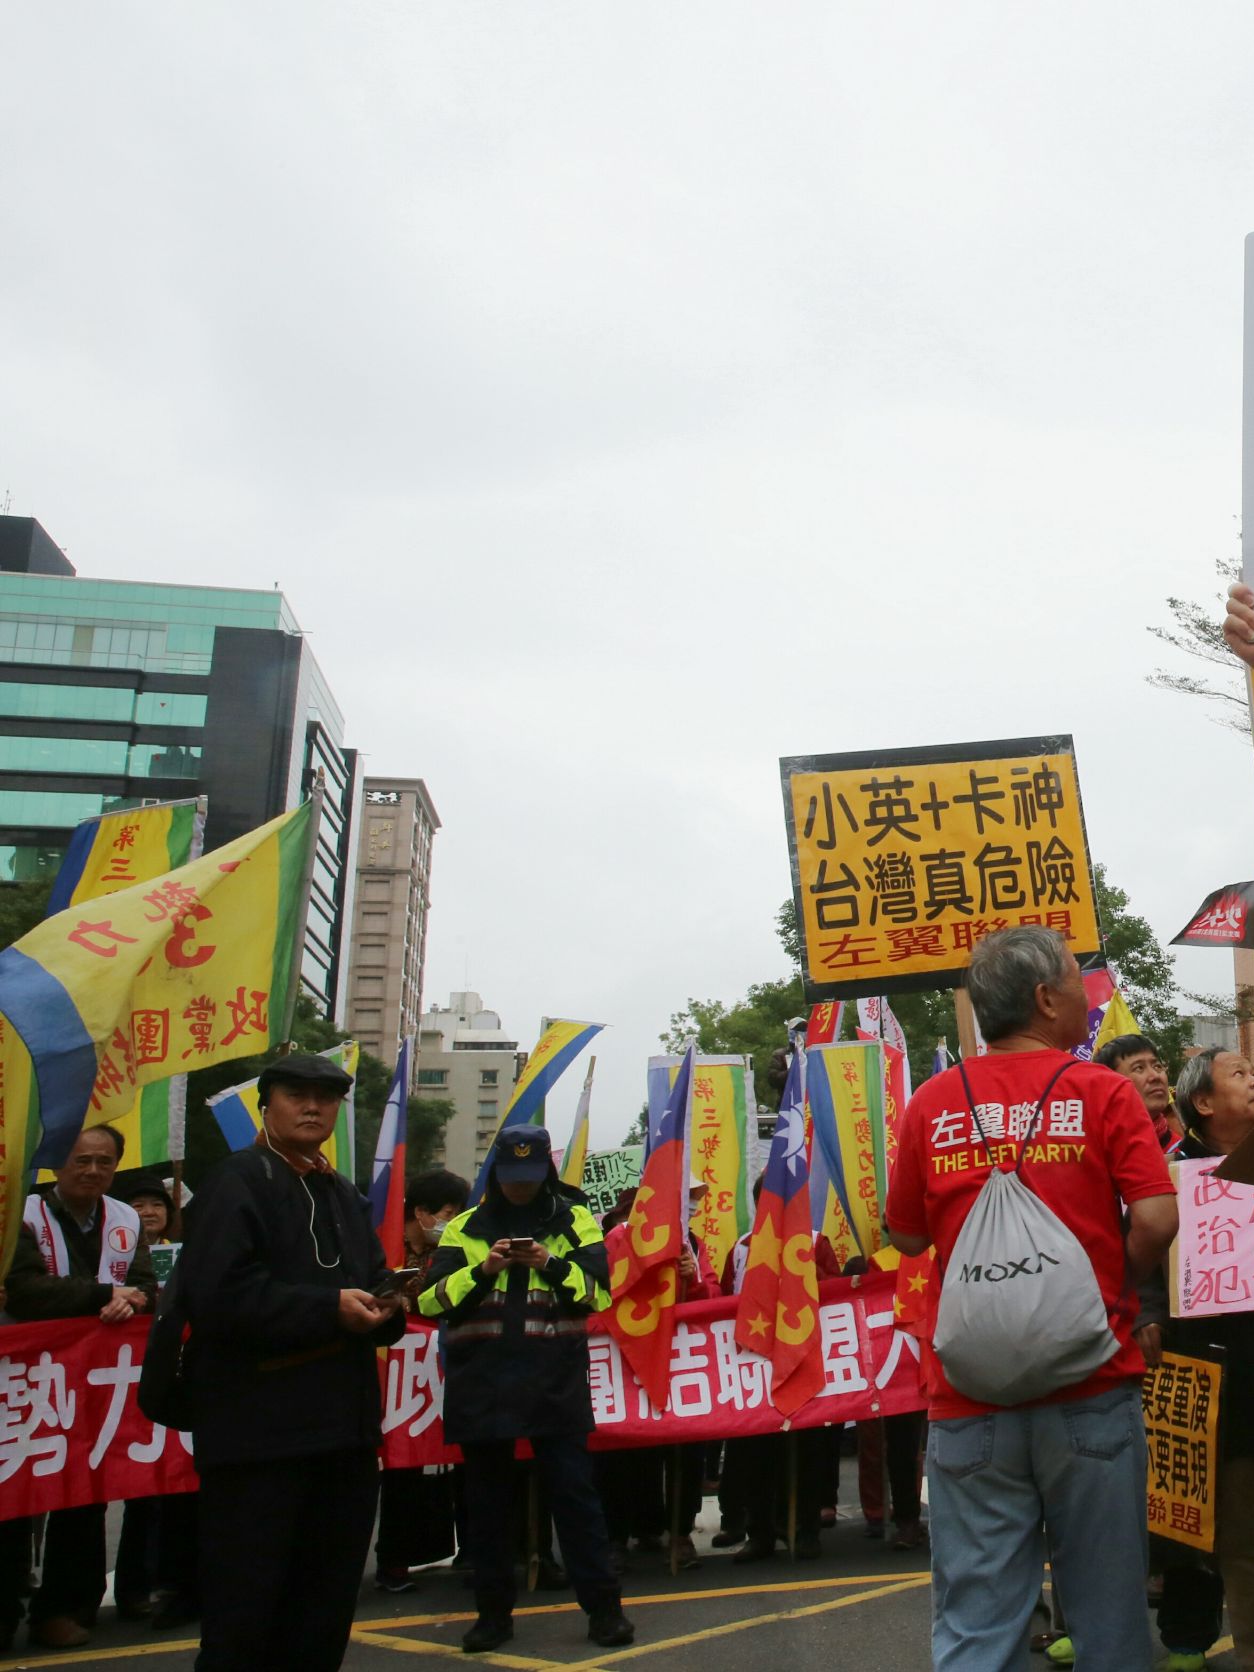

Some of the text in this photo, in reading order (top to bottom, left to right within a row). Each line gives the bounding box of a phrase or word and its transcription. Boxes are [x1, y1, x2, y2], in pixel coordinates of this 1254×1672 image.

[810, 836, 1081, 930] 台灣真危險
[931, 1099, 1086, 1149] 左翼聯盟
[932, 1143, 1086, 1174] THE LEFT PARTY
[115, 1229, 129, 1251] 1
[959, 1252, 1060, 1283] MOXA
